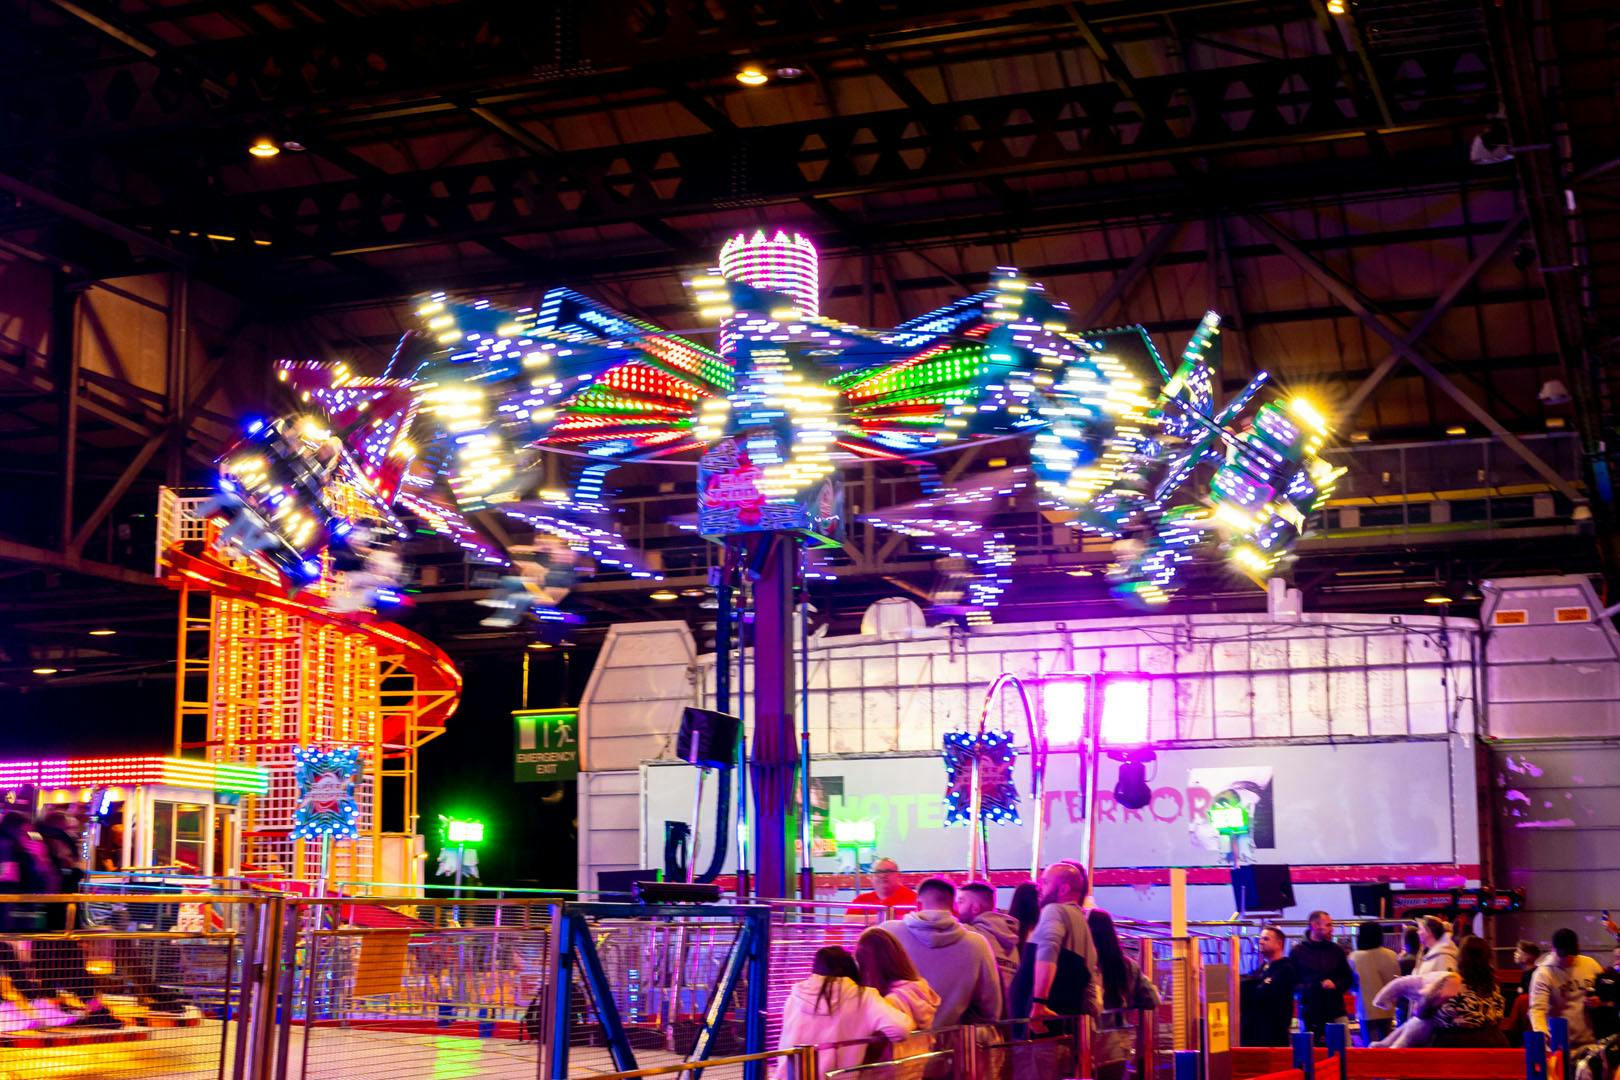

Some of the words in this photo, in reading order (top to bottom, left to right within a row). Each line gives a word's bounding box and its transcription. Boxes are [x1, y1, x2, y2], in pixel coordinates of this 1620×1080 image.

[515, 751, 576, 764] EMERGENCY
[536, 764, 558, 774] EXIT
[829, 793, 965, 842] HOTE
